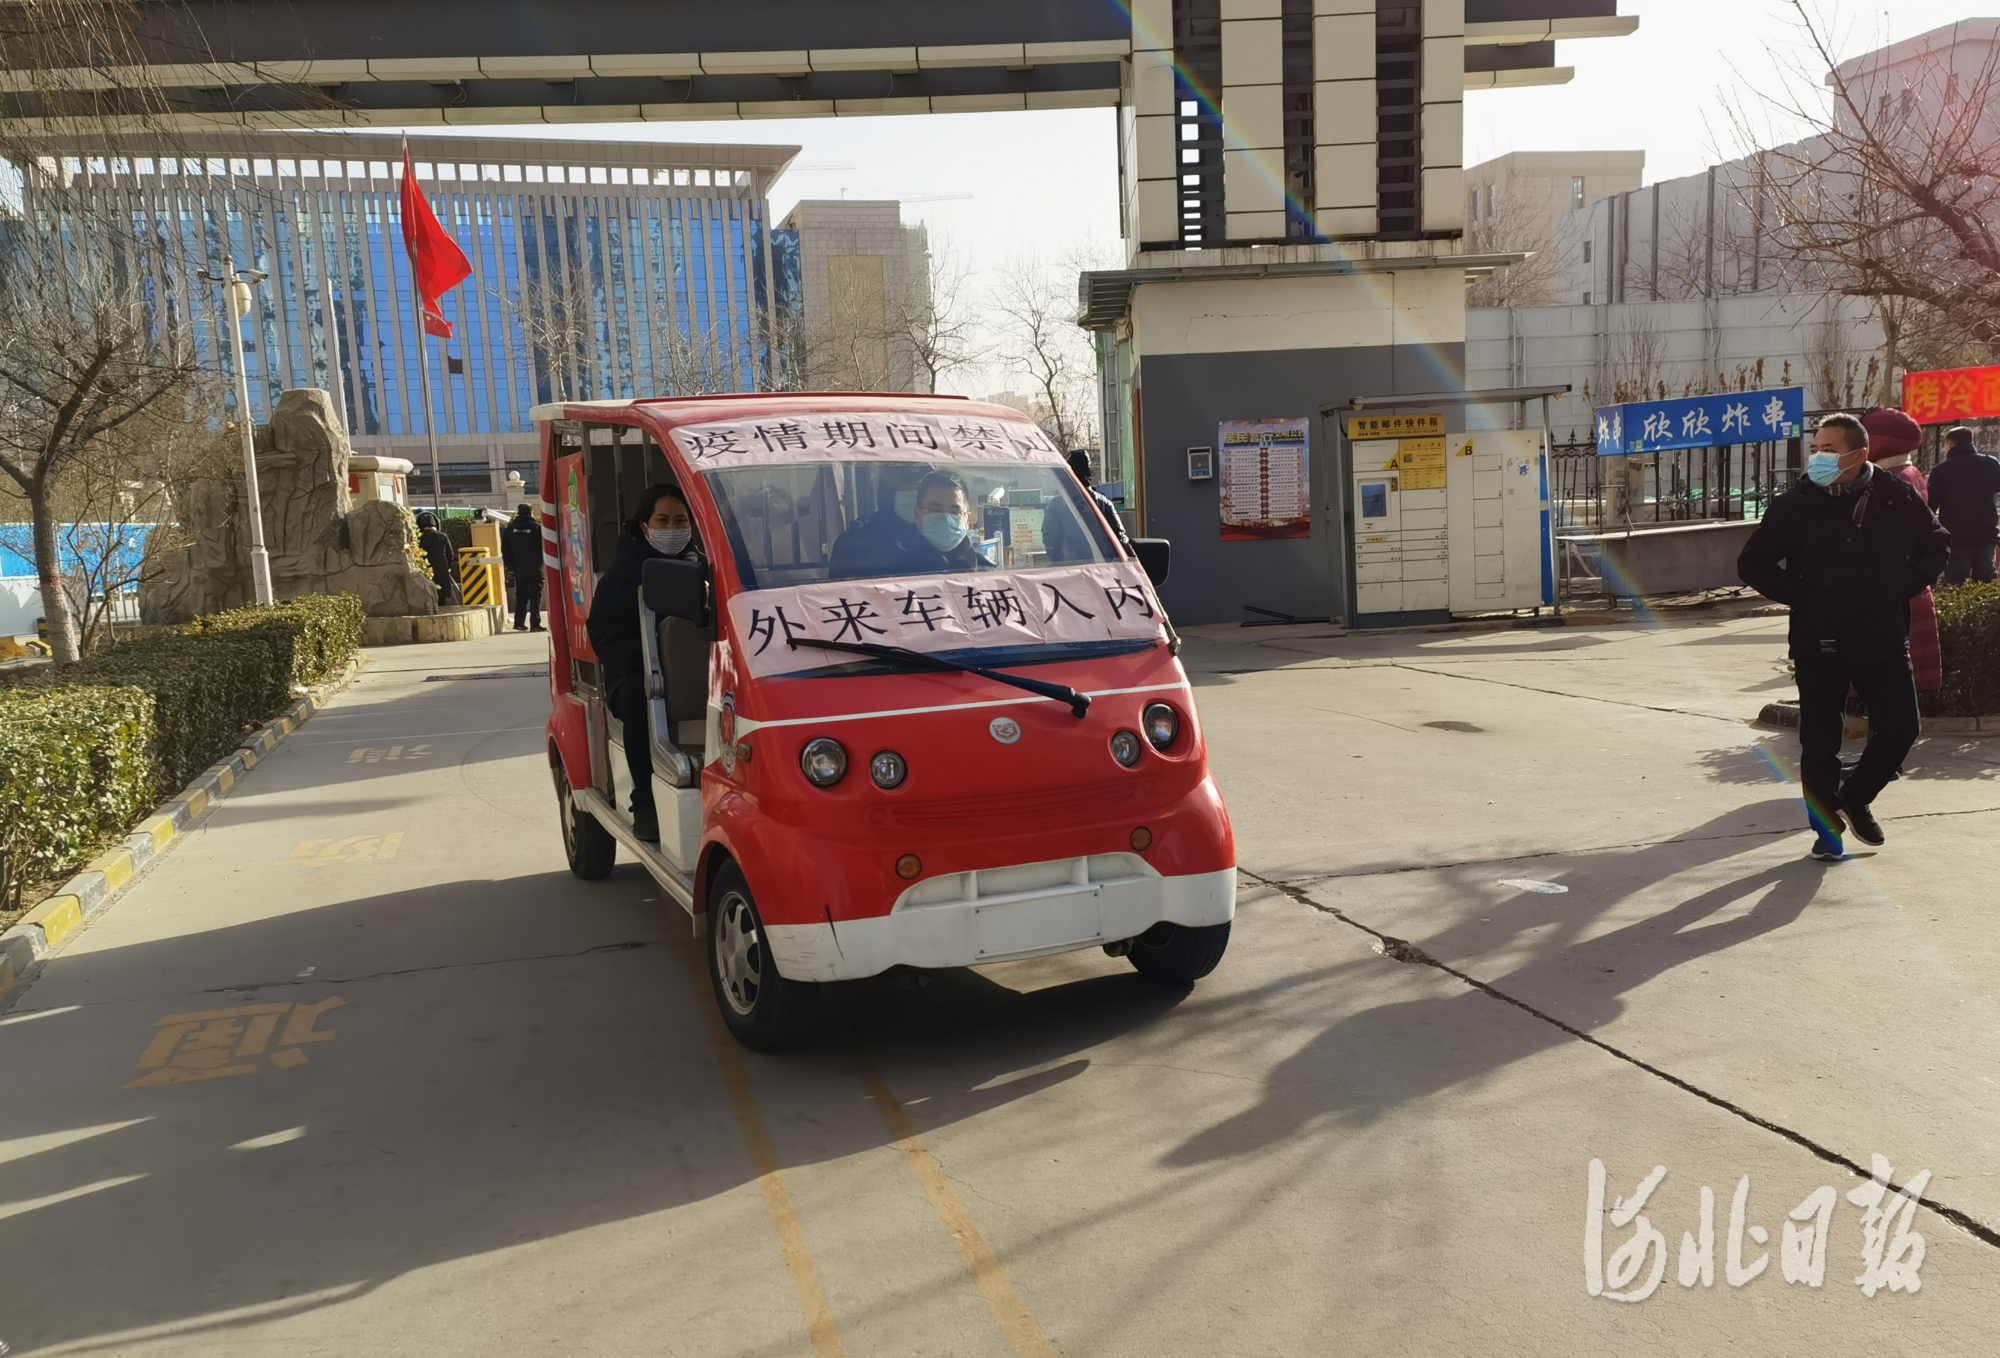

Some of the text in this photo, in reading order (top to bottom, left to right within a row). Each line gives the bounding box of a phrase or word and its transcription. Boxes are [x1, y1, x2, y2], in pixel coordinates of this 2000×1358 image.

[1358, 417, 1438, 430] 智能邮件快件箱
[1599, 412, 1622, 449] 炸串
[1643, 396, 1786, 442] 欣欣炸串
[1465, 446, 1473, 455] B
[1390, 459, 1399, 469] A
[748, 578, 1155, 656] 外来车辆入内
